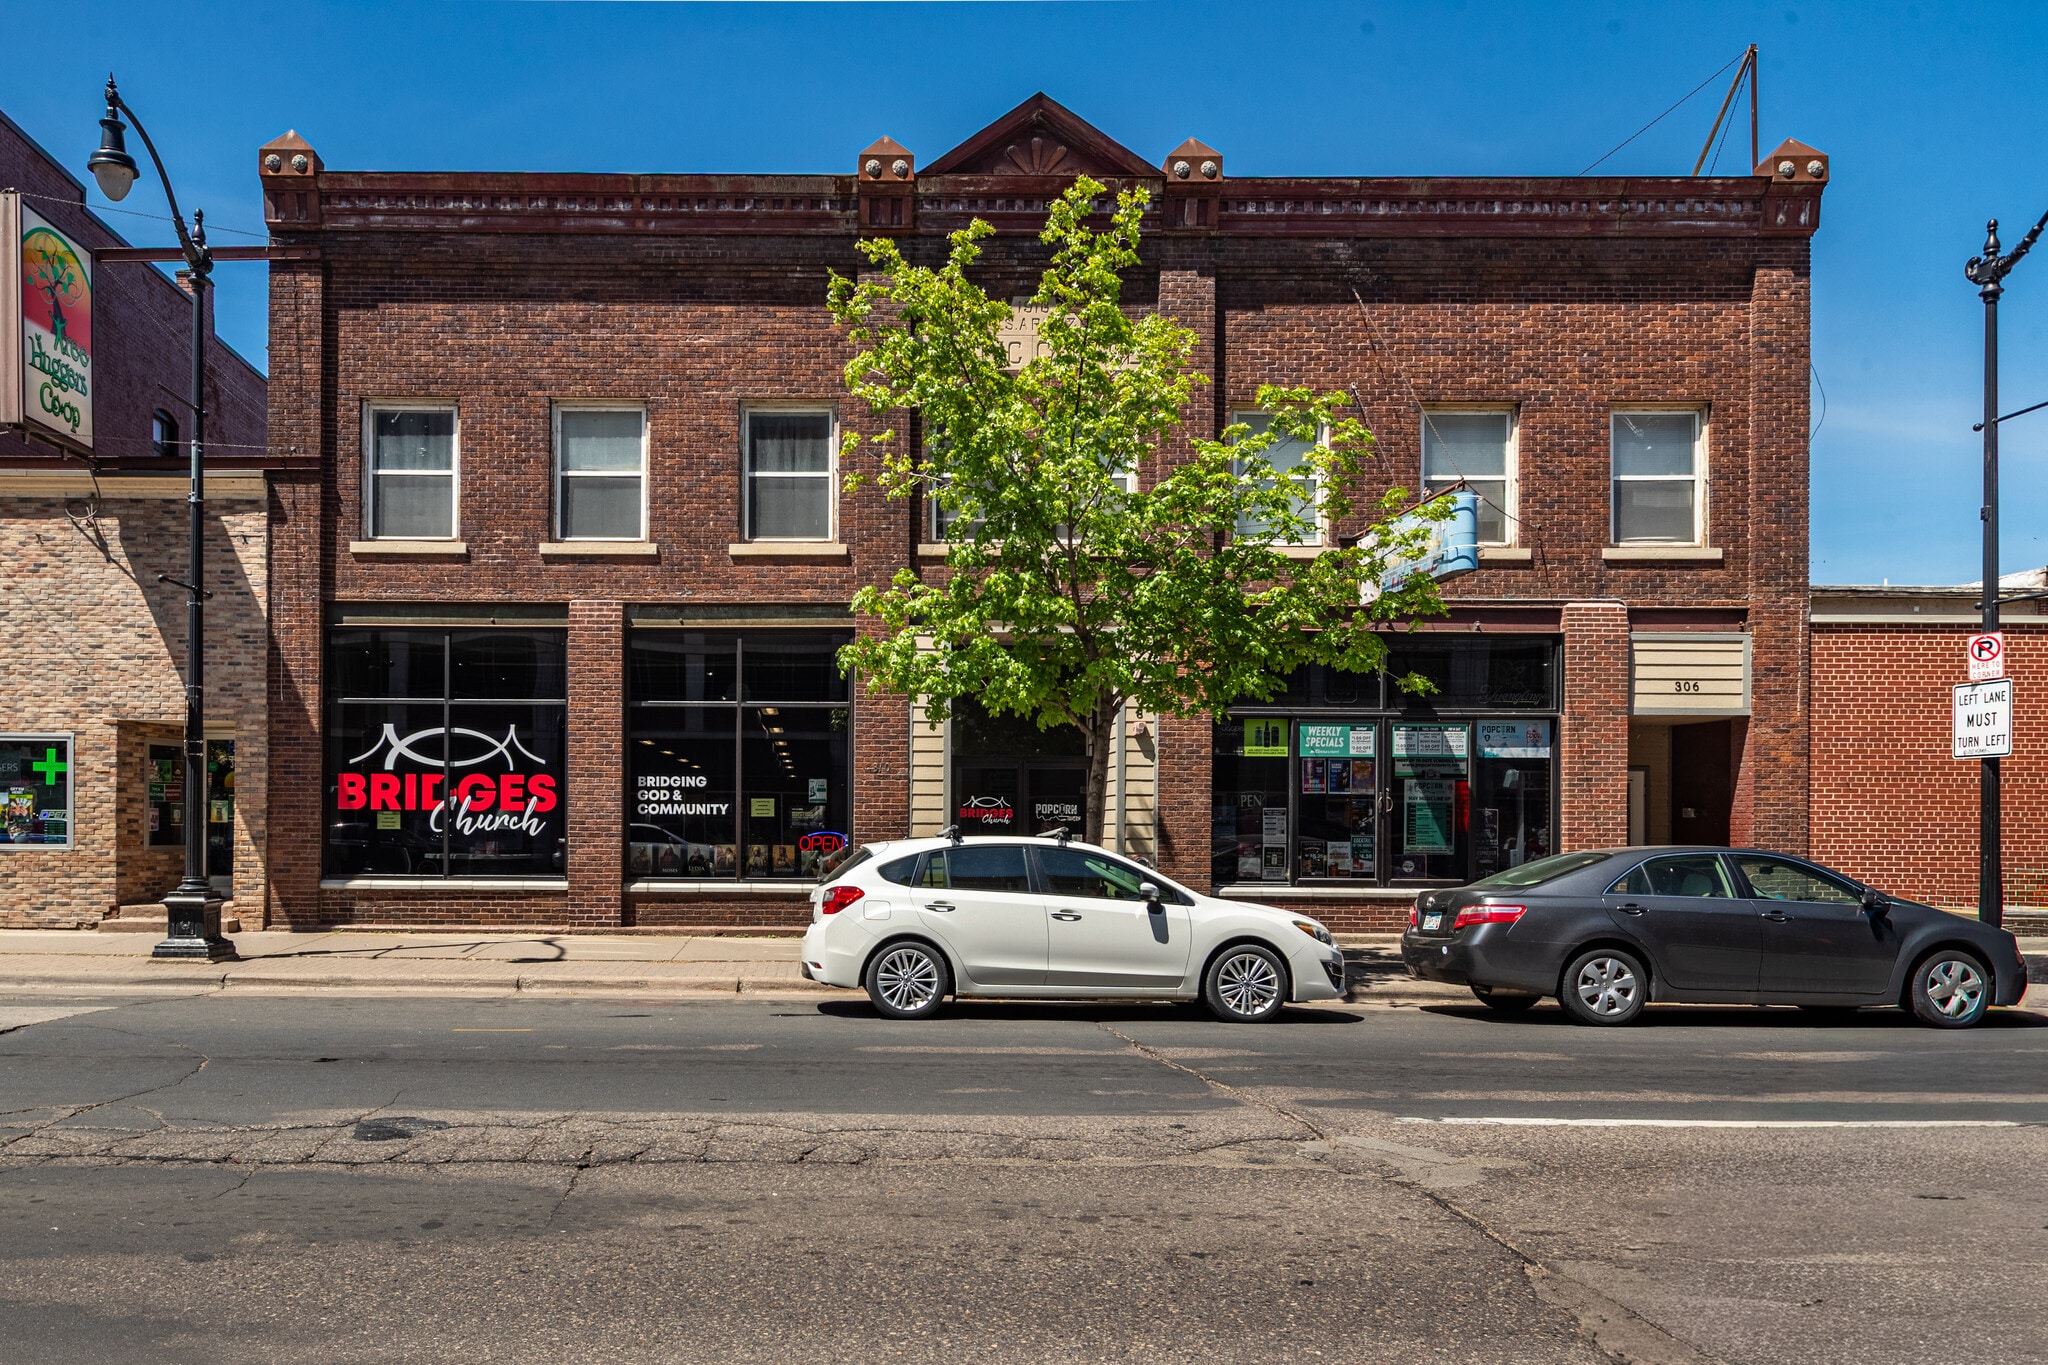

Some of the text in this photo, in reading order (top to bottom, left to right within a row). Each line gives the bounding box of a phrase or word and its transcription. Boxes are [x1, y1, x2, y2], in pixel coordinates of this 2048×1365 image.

[28, 333, 88, 397] Huggers
[1972, 660, 2000, 669] HERE TO
[1972, 669, 2000, 678] CORNER
[1675, 682, 1700, 692] 306
[1959, 690, 2006, 706] LEFT LANE
[1966, 712, 1997, 727] MUST
[1308, 727, 1342, 737] WEEKLY
[1305, 737, 1344, 747] SPECIALS
[1958, 734, 2006, 748] TURN LEFT
[637, 776, 707, 787] BRIDGING
[337, 773, 557, 812] BRIDGES
[637, 790, 682, 801] GOD &
[637, 803, 729, 815] COMMUNITY
[960, 808, 1013, 819] BRIDGES
[1035, 803, 1078, 815] POPCORN
[429, 795, 546, 836] Church
[982, 814, 1011, 824] Church
[799, 835, 845, 852] OPEN
